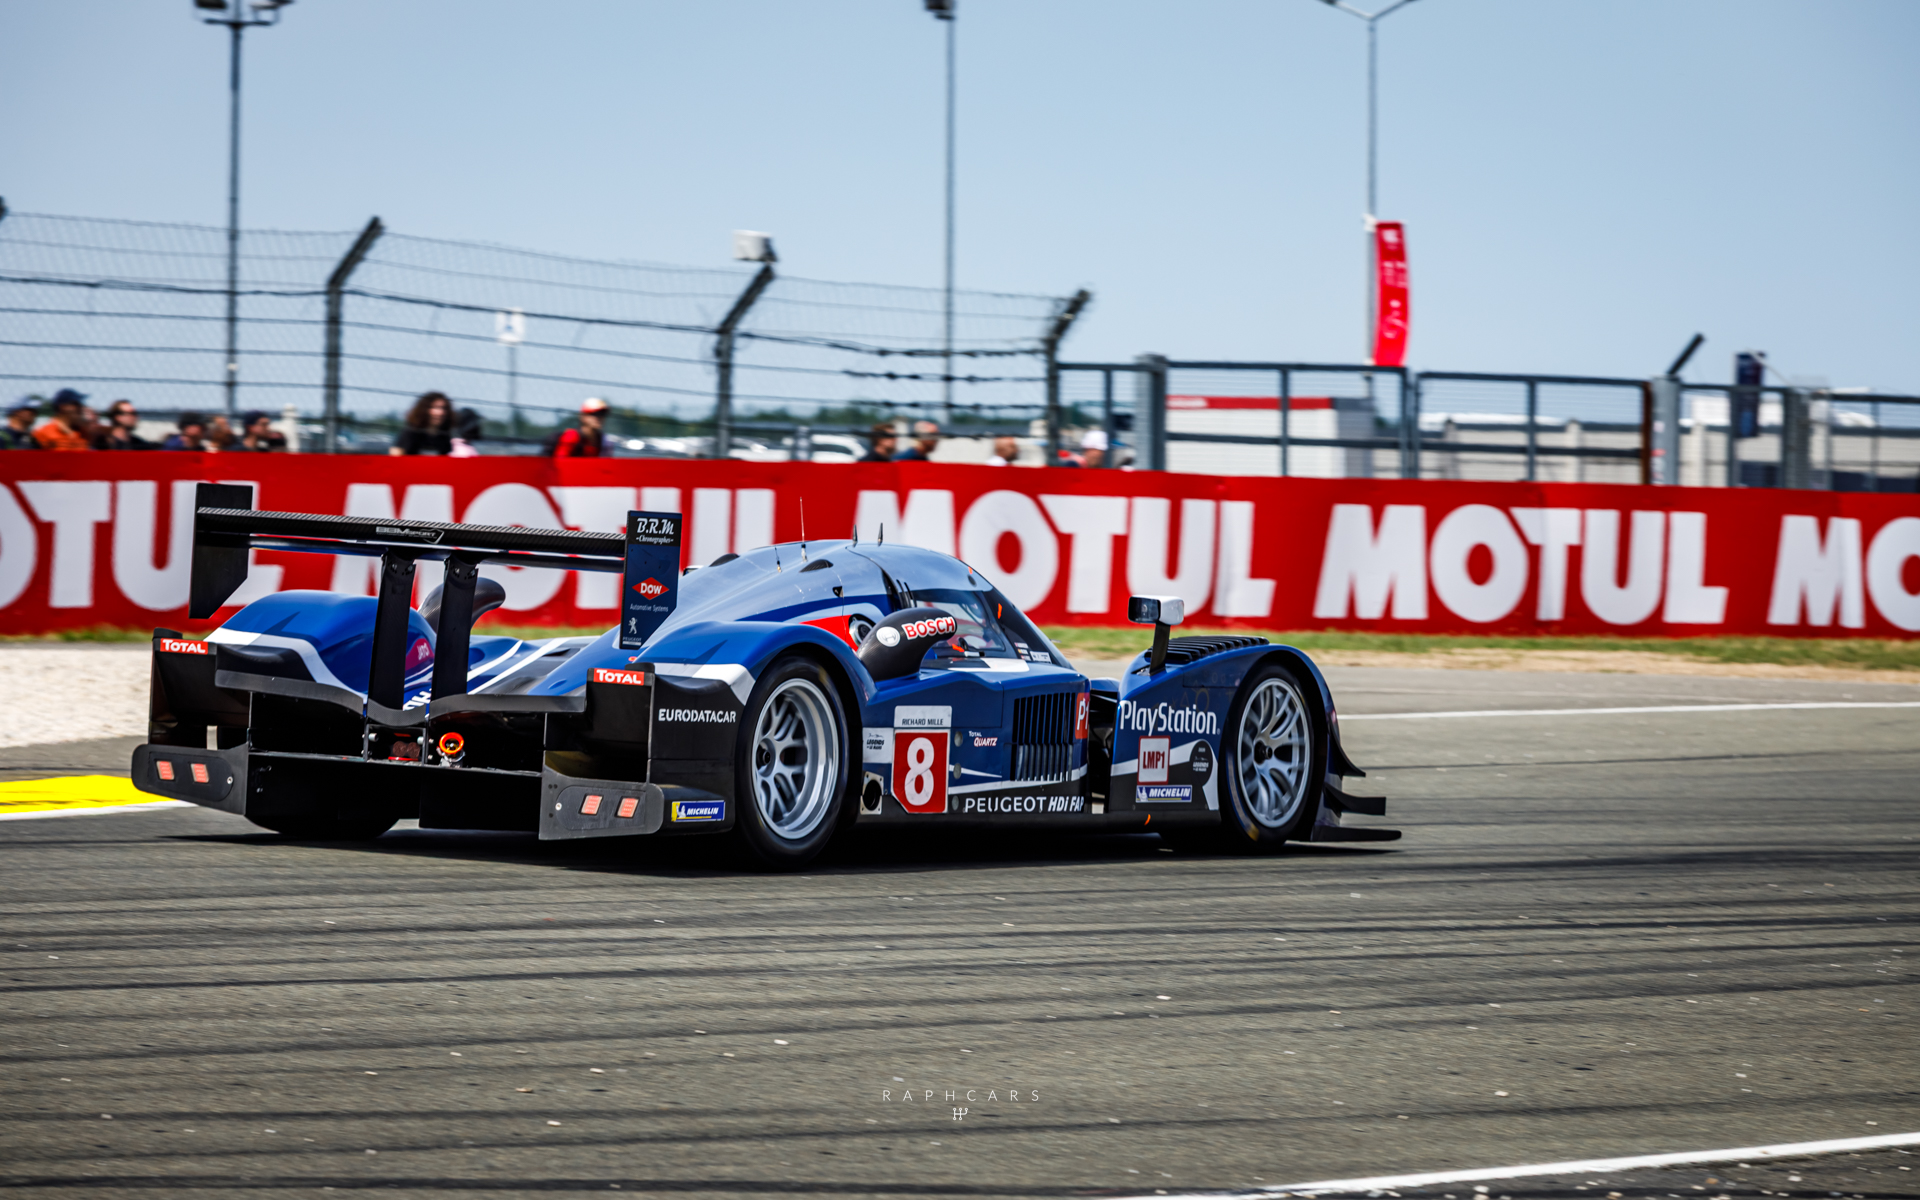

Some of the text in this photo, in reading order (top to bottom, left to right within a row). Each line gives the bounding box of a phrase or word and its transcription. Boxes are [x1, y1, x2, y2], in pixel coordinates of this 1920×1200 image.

[854, 489, 1277, 617] MOTUL
[1312, 503, 1729, 625] MOTUL
[902, 616, 956, 641] BOSCH
[658, 708, 737, 723] EURODATACAR
[902, 718, 944, 726] RICHARD MILLE
[1119, 700, 1217, 736] PlayStation
[973, 737, 998, 747] QUARTZ
[1142, 751, 1165, 769] LMP1
[904, 737, 935, 806] 8
[1149, 787, 1191, 798] MICHELIN
[686, 806, 719, 816] MICHELIN
[964, 796, 1047, 813] PEUGEOT
[1047, 796, 1069, 812] HDi
